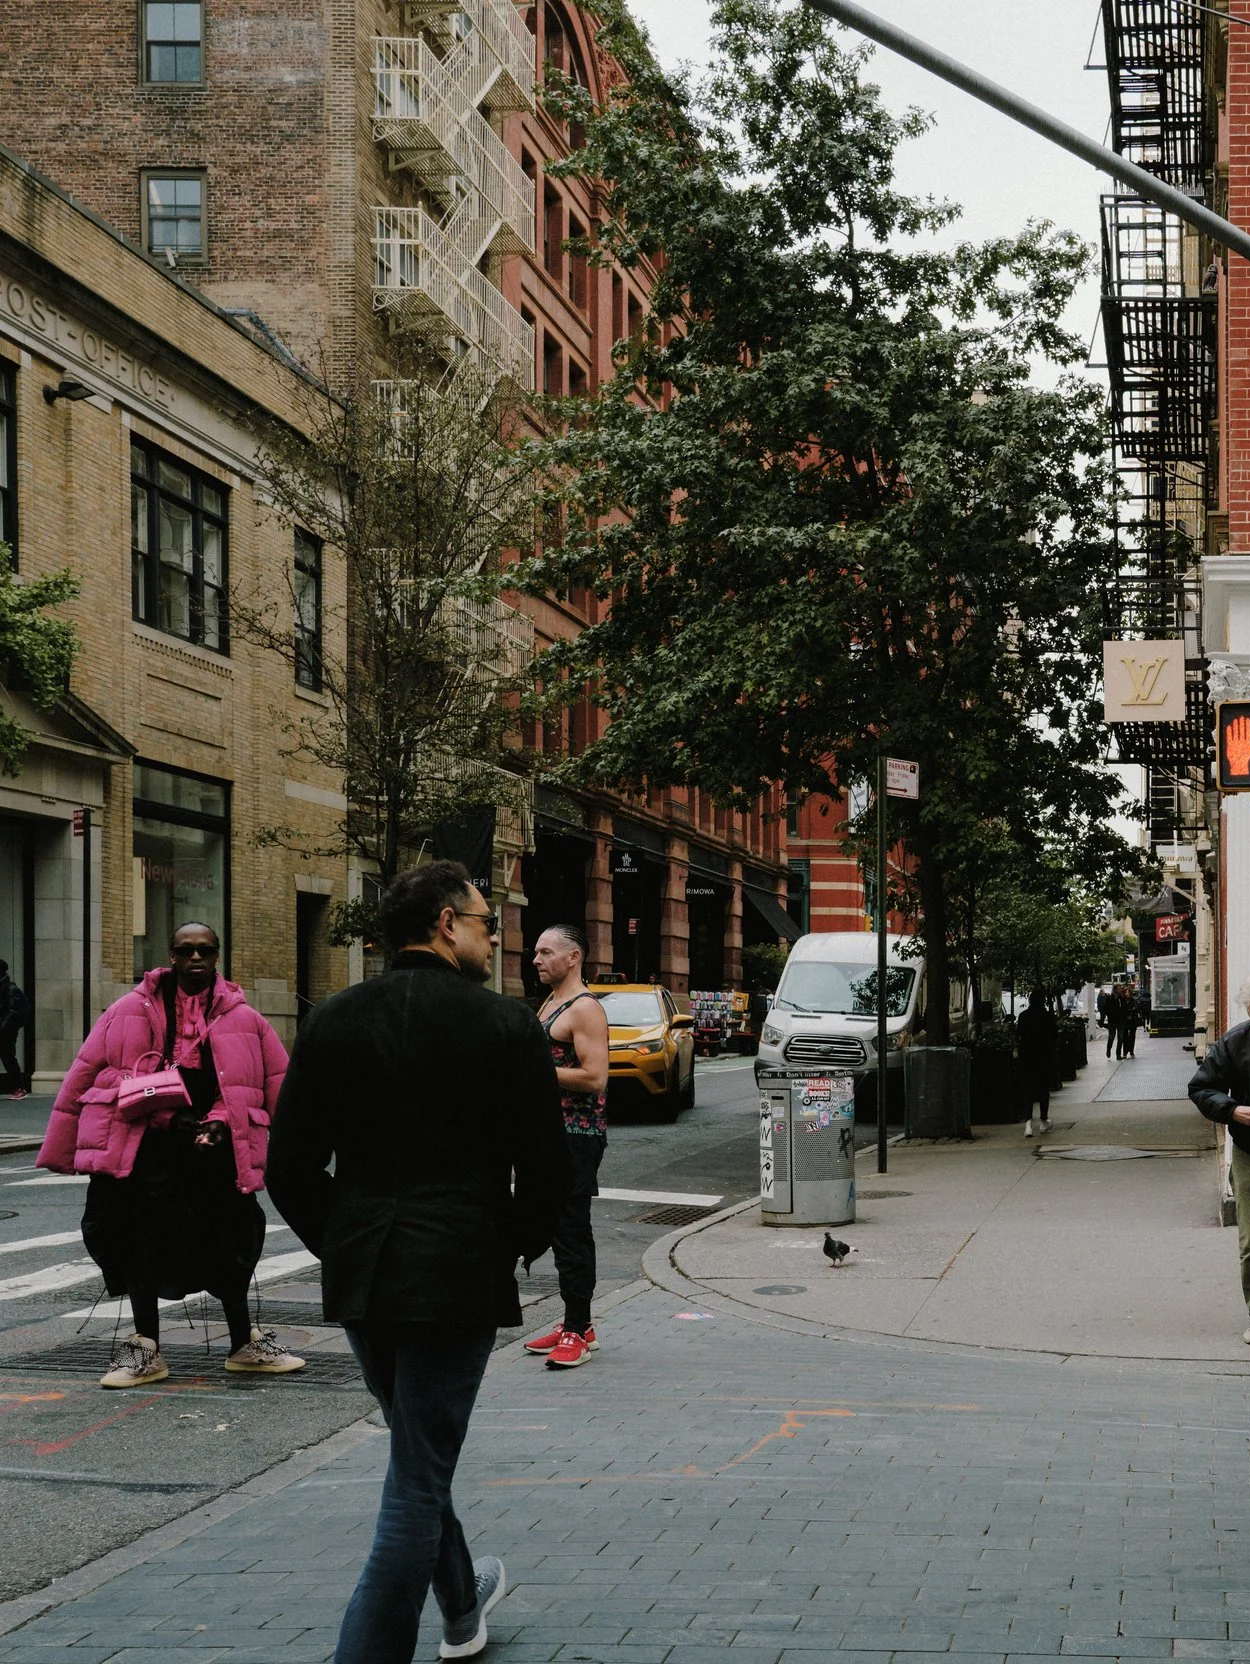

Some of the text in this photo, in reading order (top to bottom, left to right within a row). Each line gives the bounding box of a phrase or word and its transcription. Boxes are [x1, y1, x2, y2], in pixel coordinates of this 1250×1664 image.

[0, 275, 170, 409] OST-OFFICE
[888, 761, 909, 772] PARKING
[1158, 924, 1181, 939] CAF
[808, 1079, 830, 1087] READ
